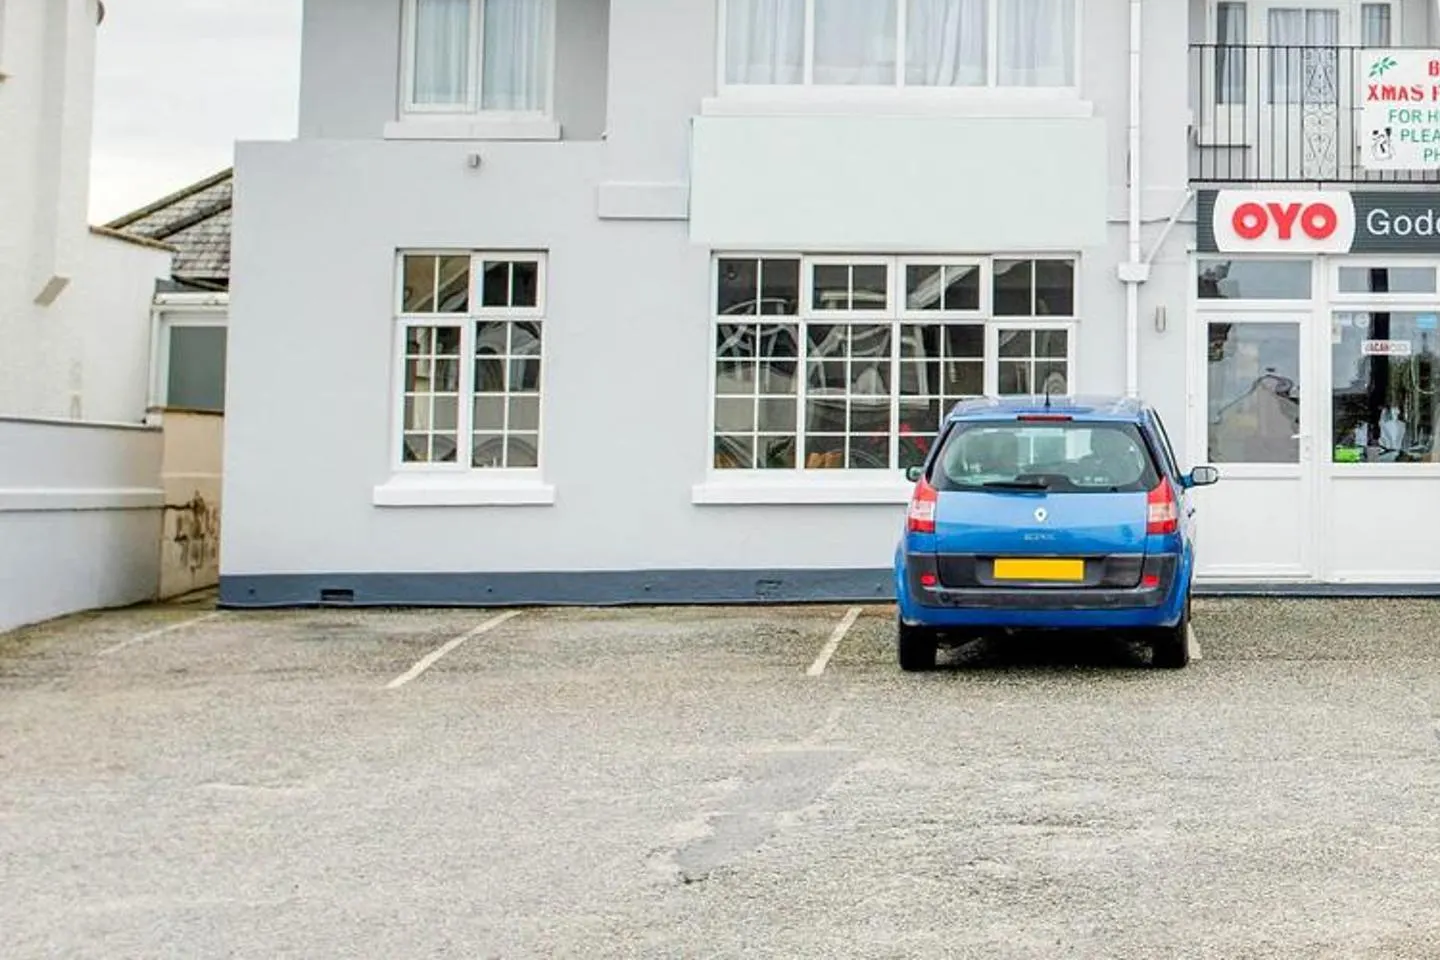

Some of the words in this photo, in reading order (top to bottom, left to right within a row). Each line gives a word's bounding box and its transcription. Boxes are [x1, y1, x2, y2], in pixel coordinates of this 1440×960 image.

[1367, 83, 1425, 102] XMAS
[1388, 108, 1423, 124] FOR
[1231, 202, 1338, 240] OYO
